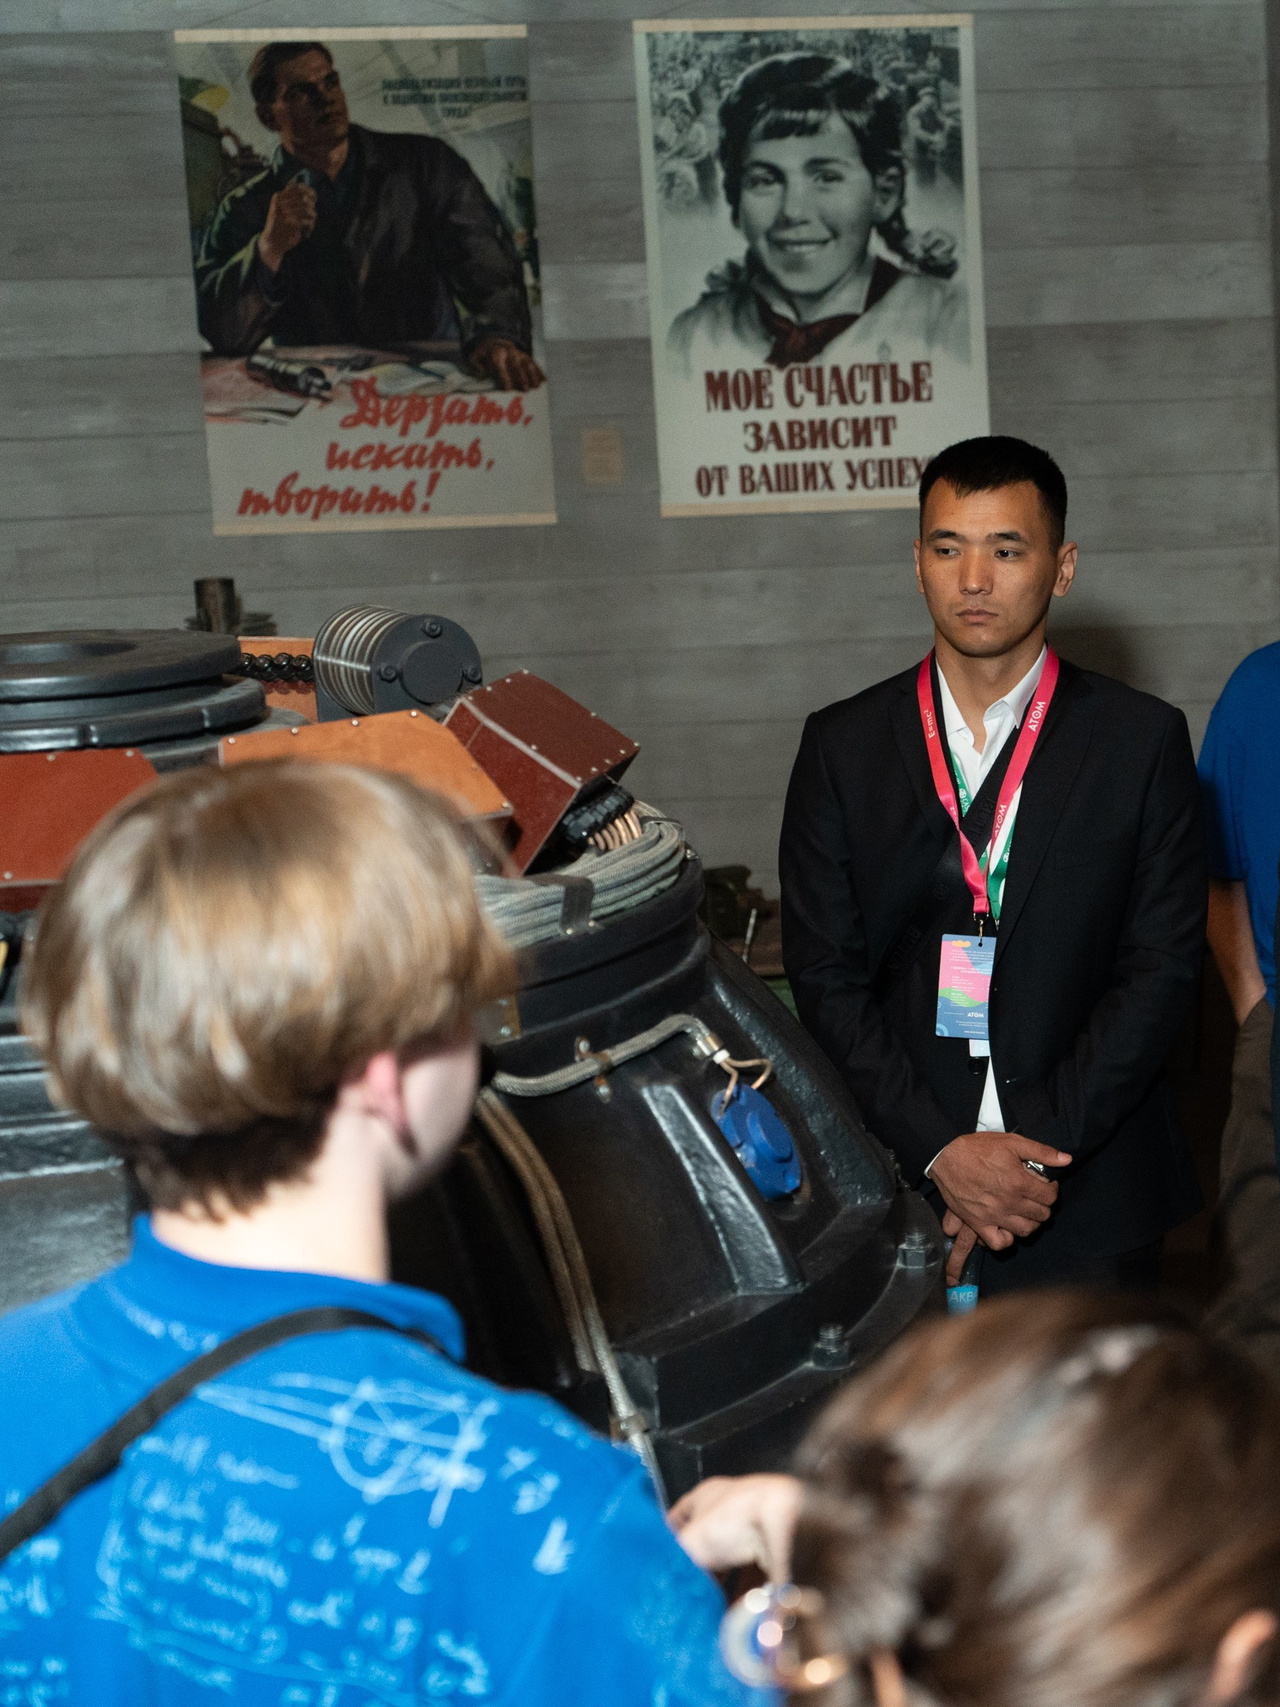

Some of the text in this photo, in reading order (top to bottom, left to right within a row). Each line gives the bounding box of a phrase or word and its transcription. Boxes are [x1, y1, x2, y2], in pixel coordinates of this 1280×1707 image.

[704, 360, 933, 413] МОЕ СЧАСТЬЕ
[340, 376, 533, 438] Дерзать,
[743, 415, 897, 453] ЗАВИСИТ
[326, 438, 494, 471] искать,
[237, 471, 441, 520] творить!
[695, 465, 728, 497] ОТ
[739, 460, 835, 495] ВАШИХ
[1027, 701, 1046, 732] ATOM
